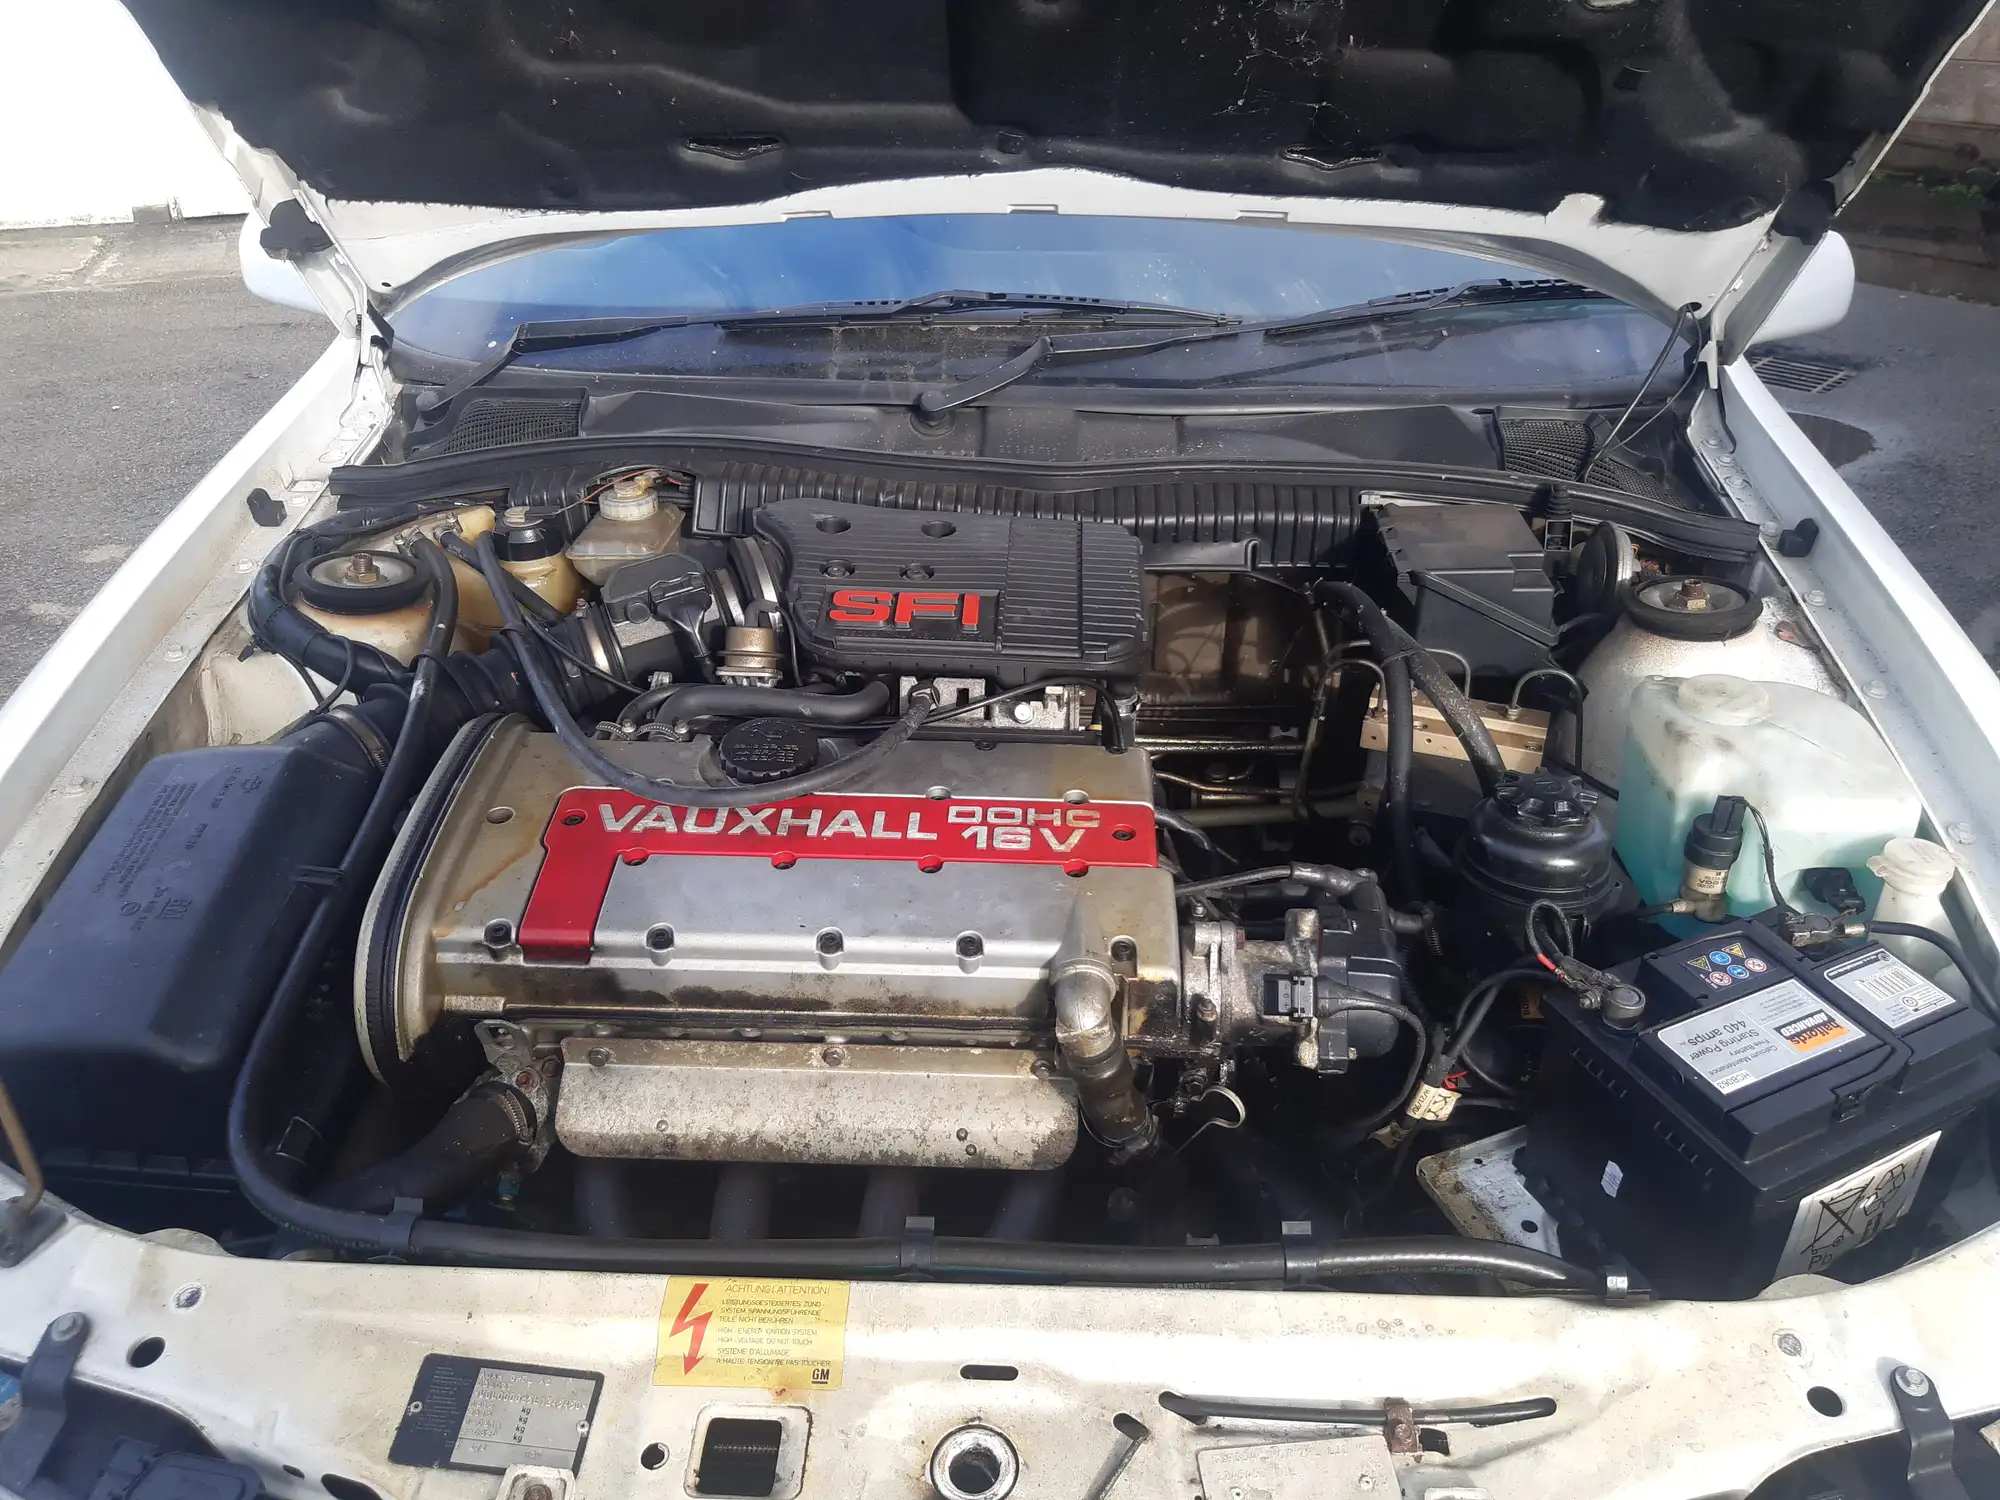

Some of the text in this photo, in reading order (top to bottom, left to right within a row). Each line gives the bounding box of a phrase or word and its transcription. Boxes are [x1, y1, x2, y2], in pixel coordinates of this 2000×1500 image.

[829, 590, 981, 625] SFI
[598, 803, 938, 841] VAUXHALL
[947, 805, 1101, 828] DOHC
[1687, 1019, 1748, 1045] 440 amps
[1778, 1012, 1830, 1036] ADVANCED
[1787, 1020, 1844, 1047] halfords
[1688, 1028, 1759, 1061] Starting Power
[1728, 1039, 1770, 1057] Free Battery
[1750, 1045, 1778, 1058] Calcium
[1716, 1072, 1751, 1089] HCB063
[812, 1368, 830, 1381] GM
[522, 1406, 531, 1415] kg
[515, 1424, 525, 1434] kg
[519, 1415, 528, 1425] kg
[512, 1434, 522, 1443] kg
